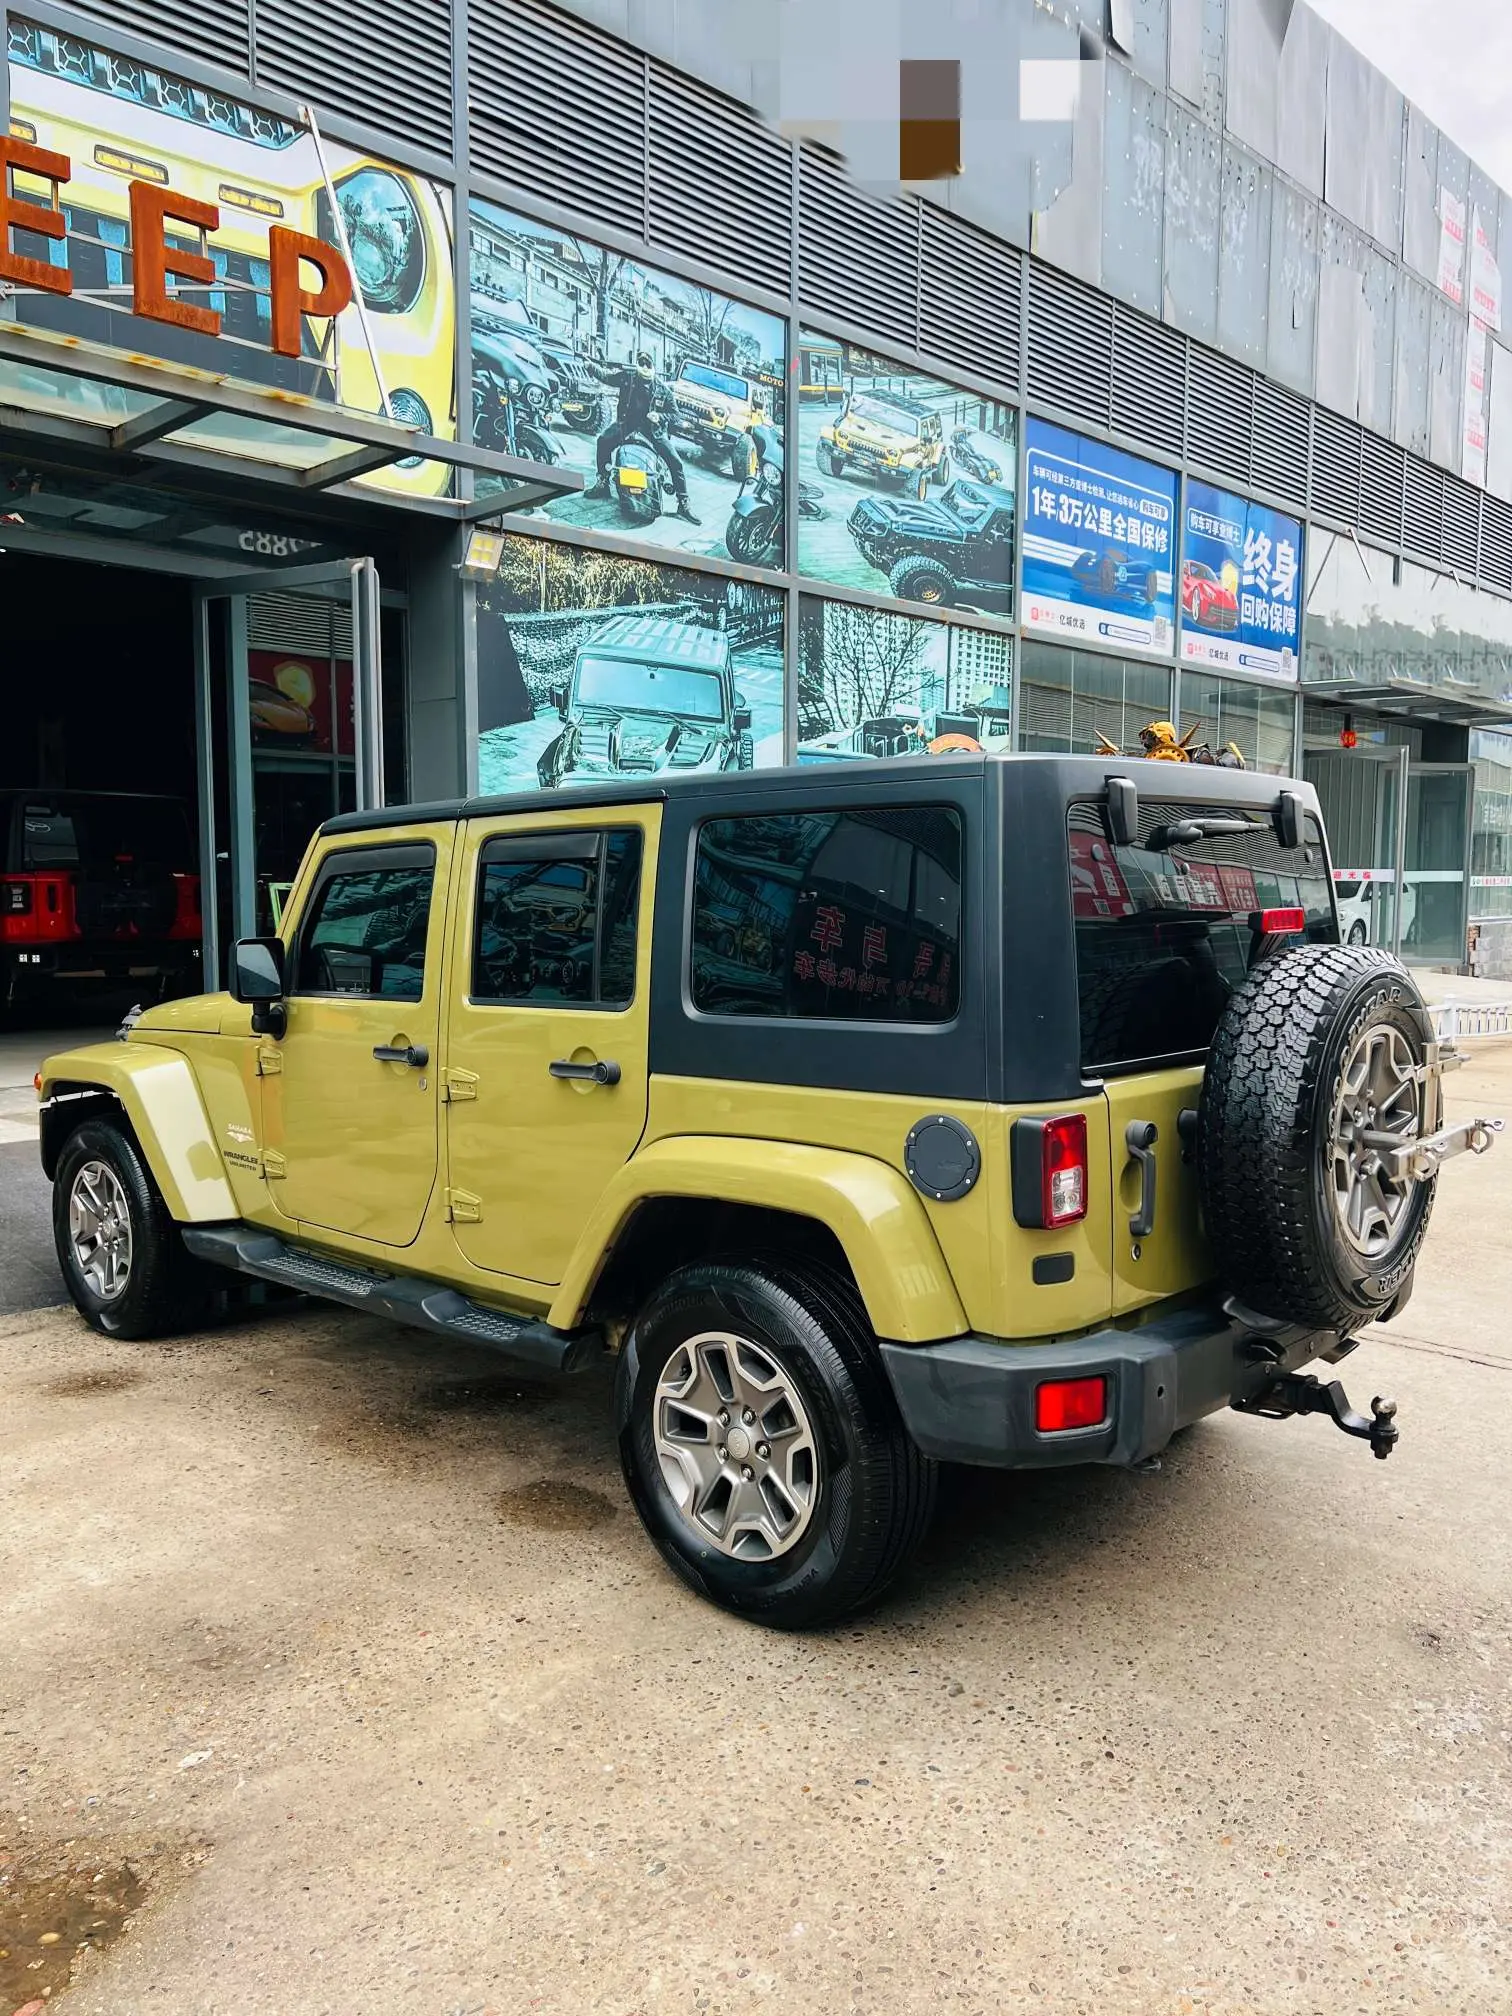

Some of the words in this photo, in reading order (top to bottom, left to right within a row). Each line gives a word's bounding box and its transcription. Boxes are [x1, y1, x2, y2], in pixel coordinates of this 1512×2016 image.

[759, 373, 784, 387] MOTO
[1243, 527, 1298, 602] 终身
[1241, 592, 1297, 637] 回购保障
[224, 1151, 258, 1165] WRANGLER
